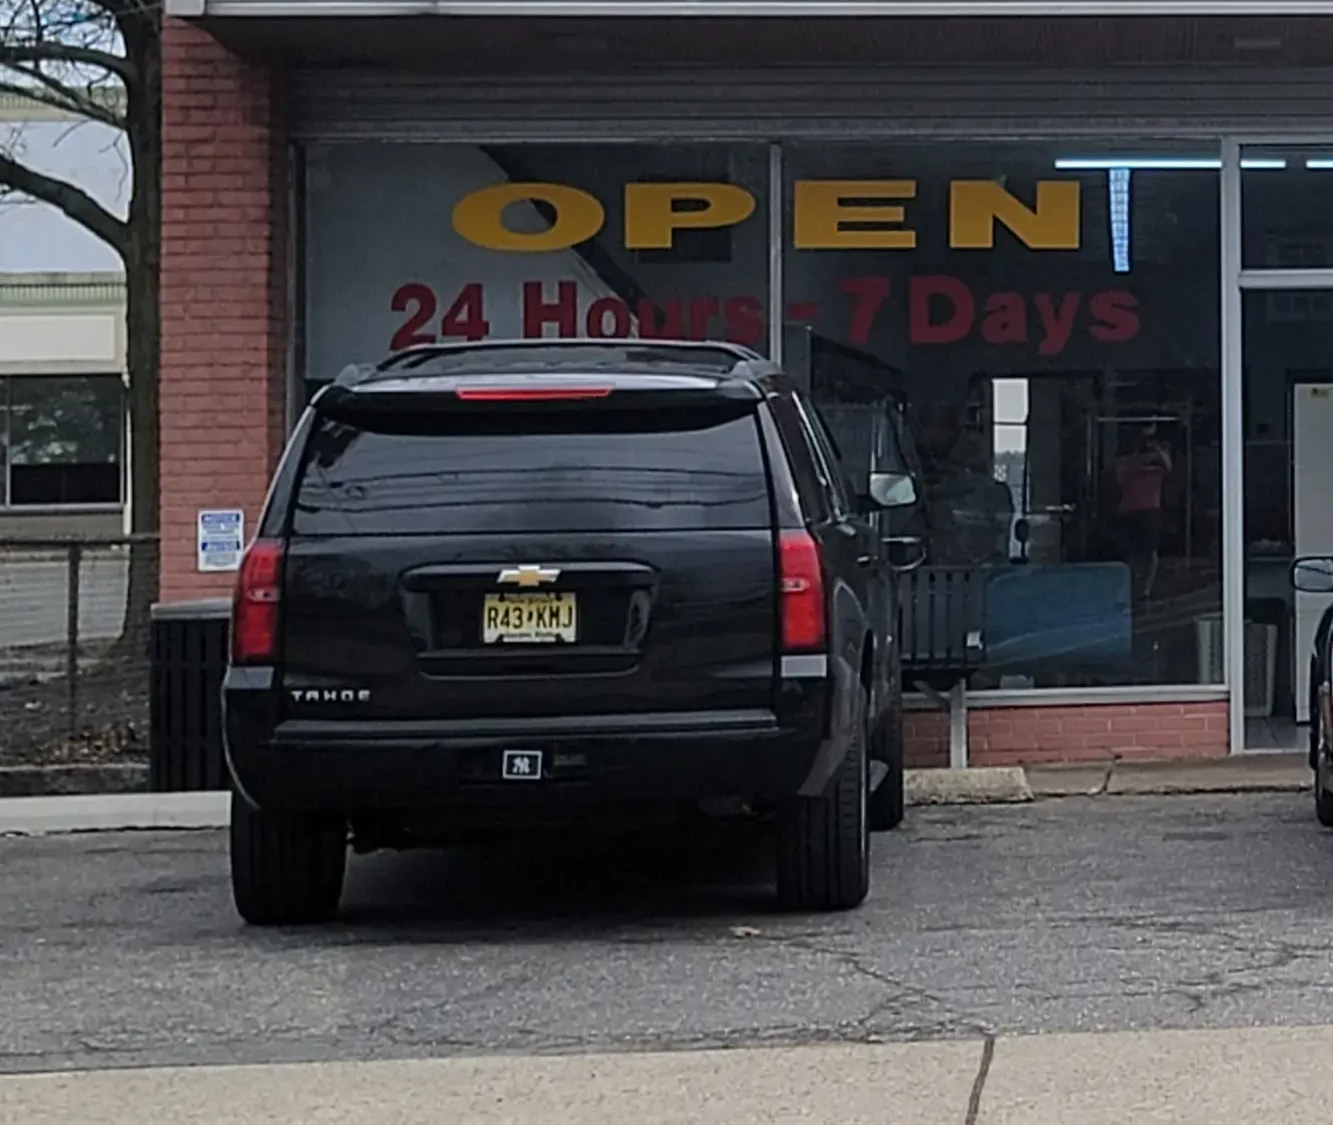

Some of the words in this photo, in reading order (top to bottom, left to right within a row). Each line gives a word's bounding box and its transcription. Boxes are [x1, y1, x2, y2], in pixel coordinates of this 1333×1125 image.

[451, 179, 1080, 251] OPEN
[388, 283, 490, 350] 24
[521, 281, 766, 343] Hours
[842, 278, 887, 343] 7
[908, 277, 1140, 354] Days
[290, 689, 372, 703] TAHOE
